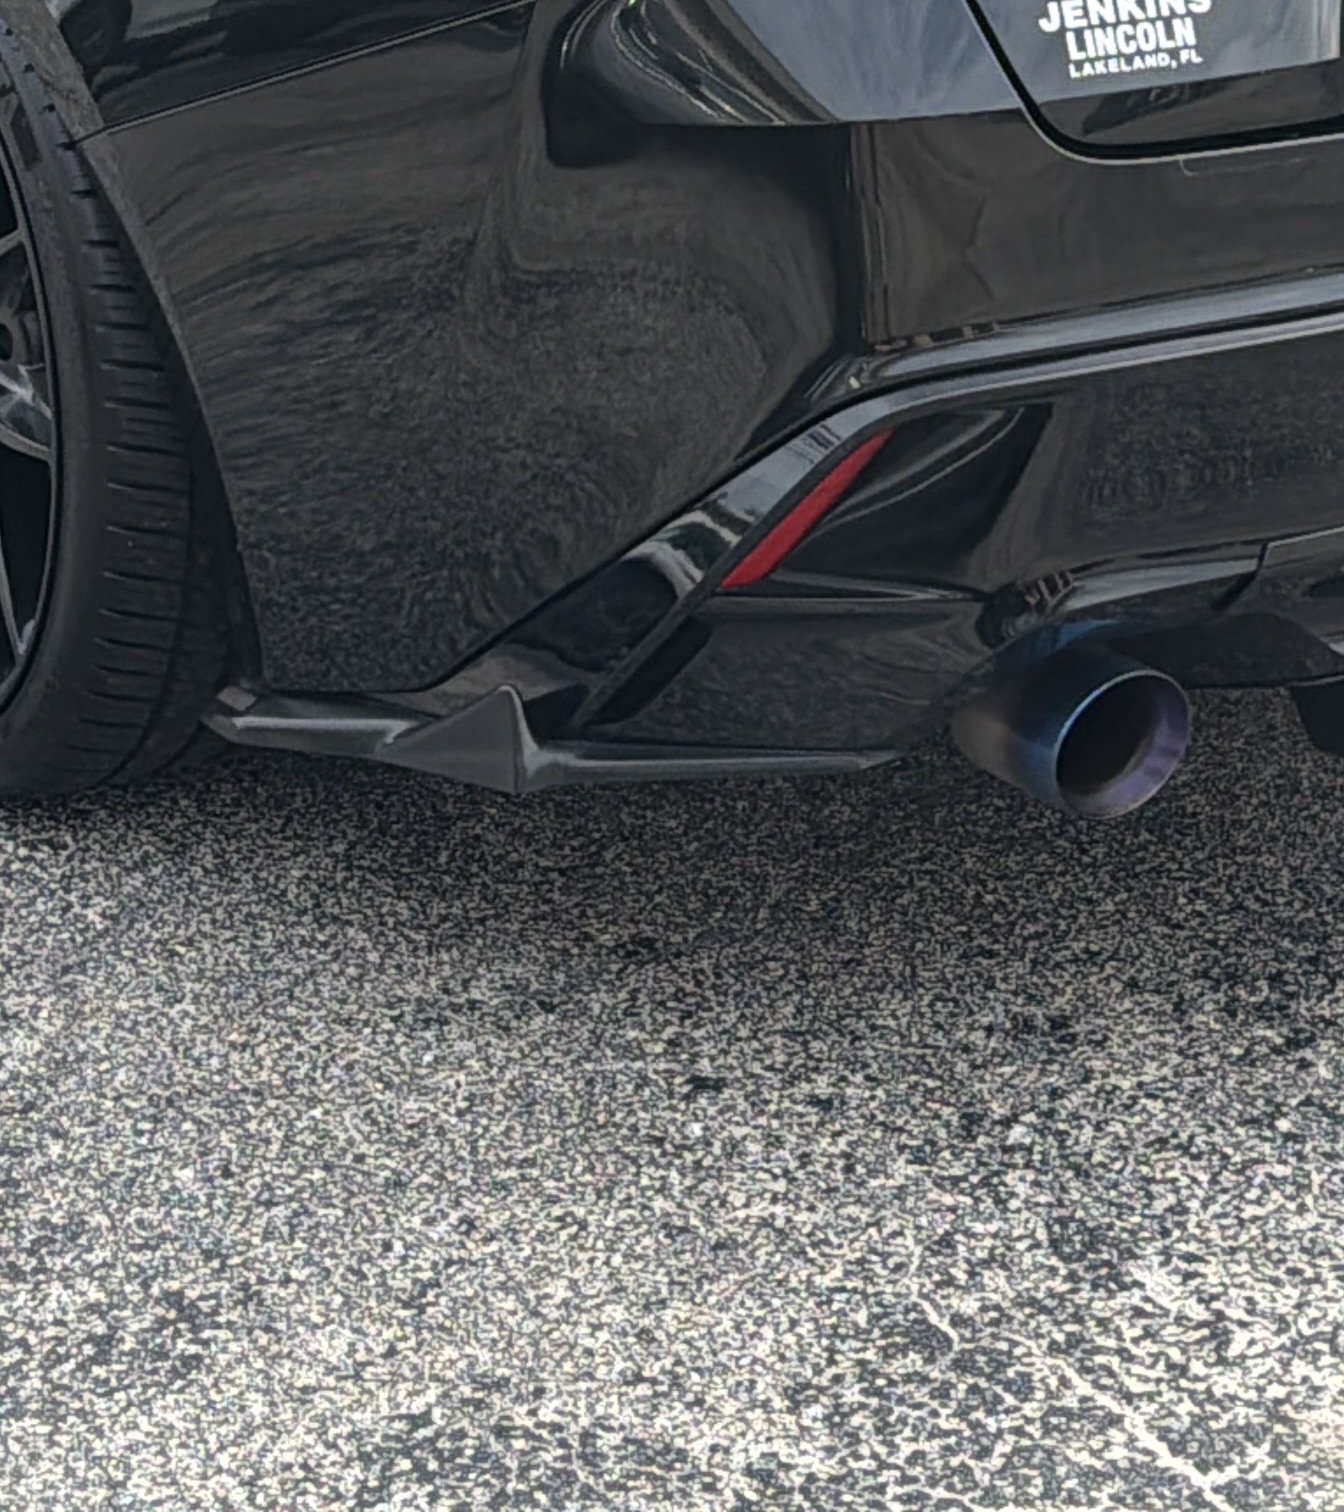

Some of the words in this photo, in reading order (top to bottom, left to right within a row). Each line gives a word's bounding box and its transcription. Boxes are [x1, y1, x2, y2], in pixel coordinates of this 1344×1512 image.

[1065, 17, 1198, 62] LINCOLN
[1068, 52, 1177, 79] LAKELAND,
[1179, 48, 1203, 64] FL
